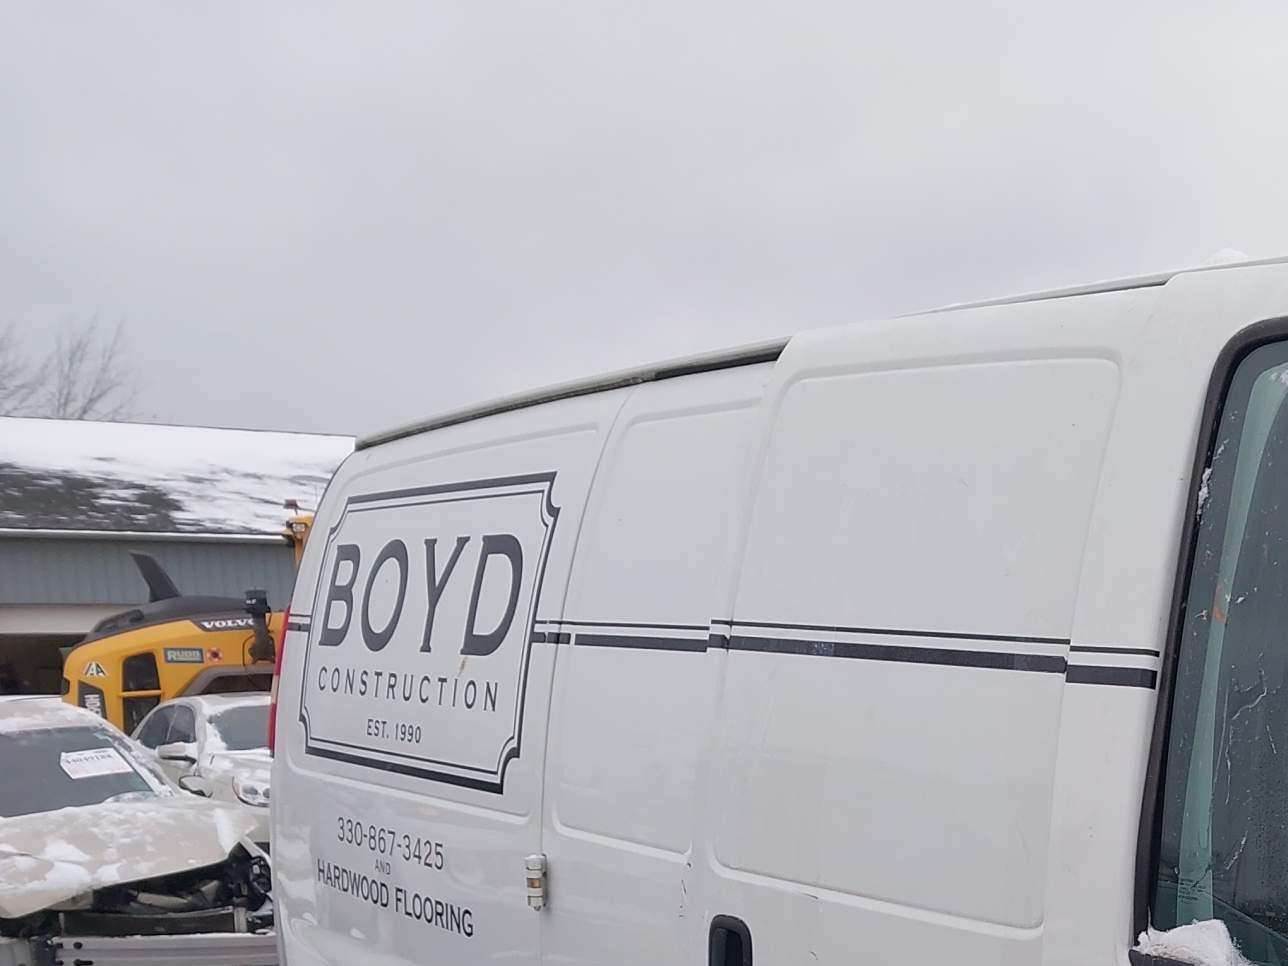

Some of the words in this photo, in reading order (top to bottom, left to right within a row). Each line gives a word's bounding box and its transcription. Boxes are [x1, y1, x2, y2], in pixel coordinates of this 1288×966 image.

[318, 534, 523, 656] BOYD
[318, 666, 498, 712] CONSTRUCTION
[366, 718, 389, 739] EST.
[395, 723, 422, 744] 1990
[337, 816, 444, 870] 330-867-3425
[374, 858, 391, 875] AND
[317, 858, 389, 908] HARDWOOD
[395, 886, 474, 938] FLOORING
